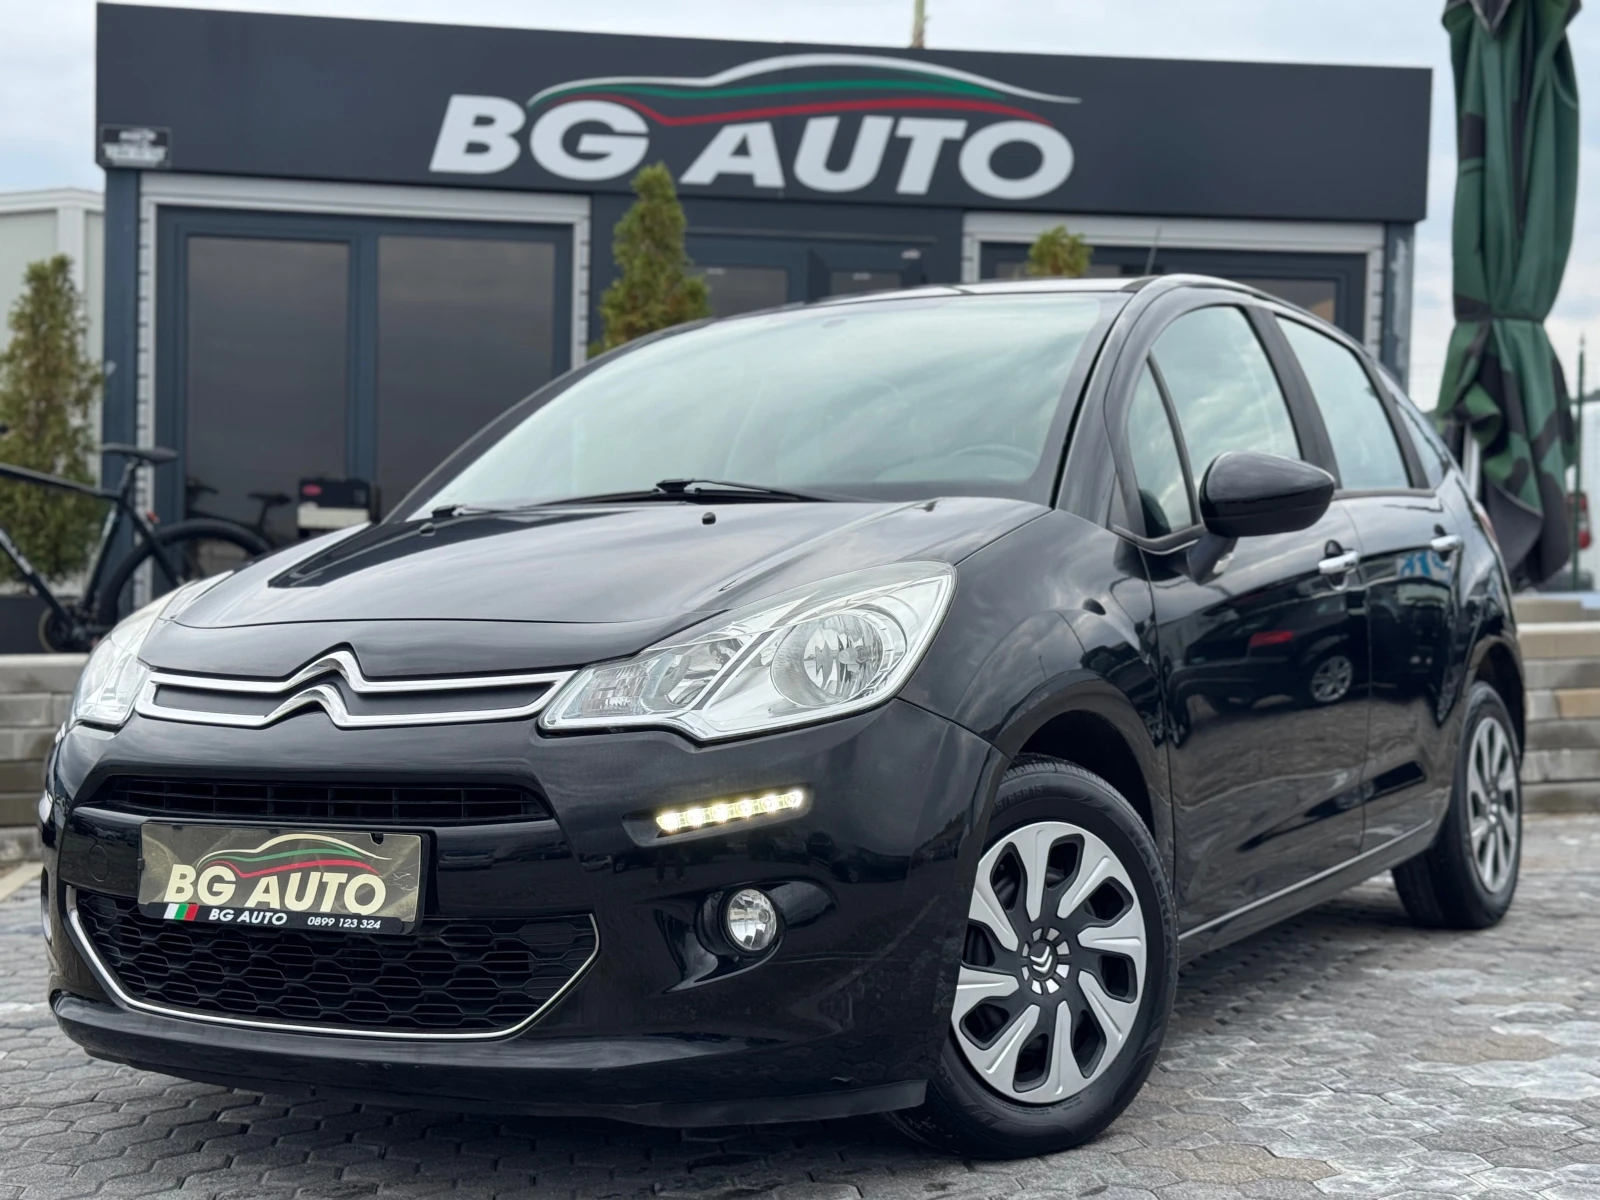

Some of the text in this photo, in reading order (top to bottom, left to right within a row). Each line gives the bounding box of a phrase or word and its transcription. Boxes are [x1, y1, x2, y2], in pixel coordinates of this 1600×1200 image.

[429, 94, 1074, 199] BG AUTO
[163, 864, 386, 916] BG AUTO
[208, 908, 382, 930] BG AUTO 0899 123 324
